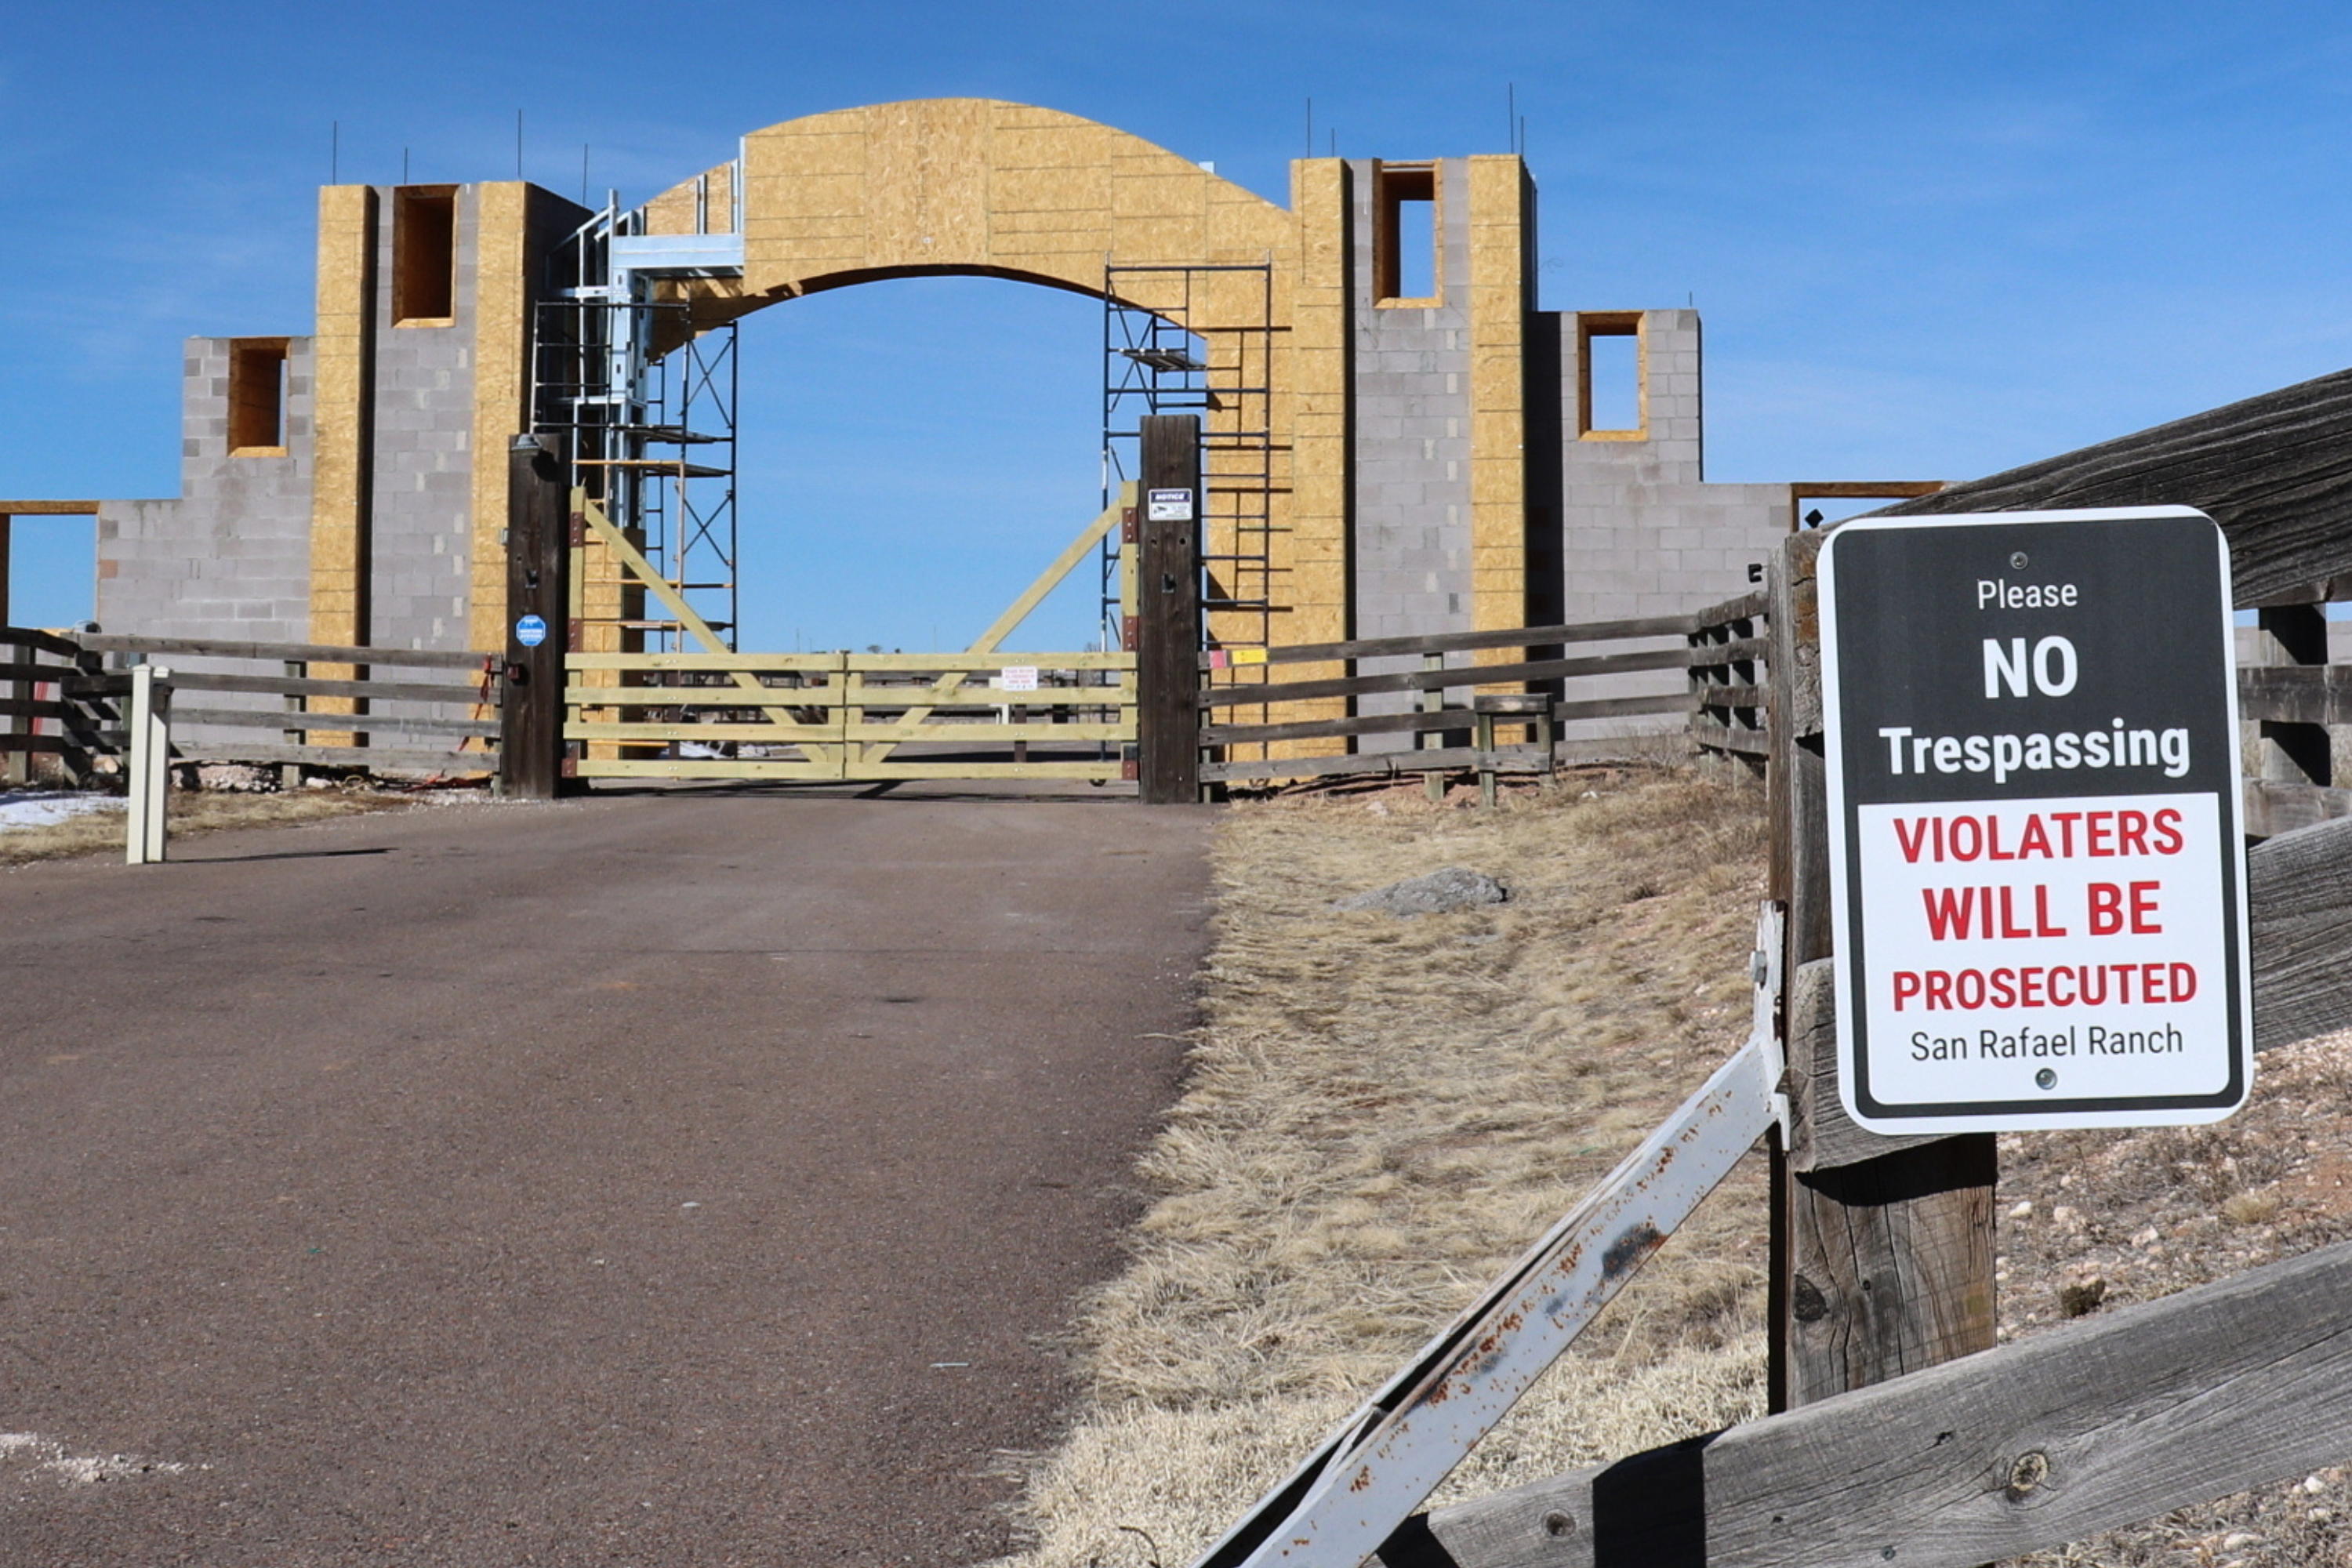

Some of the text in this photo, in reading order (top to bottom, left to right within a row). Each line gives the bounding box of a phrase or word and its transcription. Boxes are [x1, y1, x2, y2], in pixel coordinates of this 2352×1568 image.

[1155, 492, 1185, 501] NOTICE
[1978, 579, 2078, 610] Please
[1983, 636, 2078, 699] NO
[1878, 717, 2190, 784] Trespassing
[1894, 808, 2183, 863] VIOLATERS
[1923, 881, 2162, 941] WILL BE
[1893, 963, 2197, 1012] PROSECUTED
[1911, 1022, 2183, 1062] San Rafael Ranch
